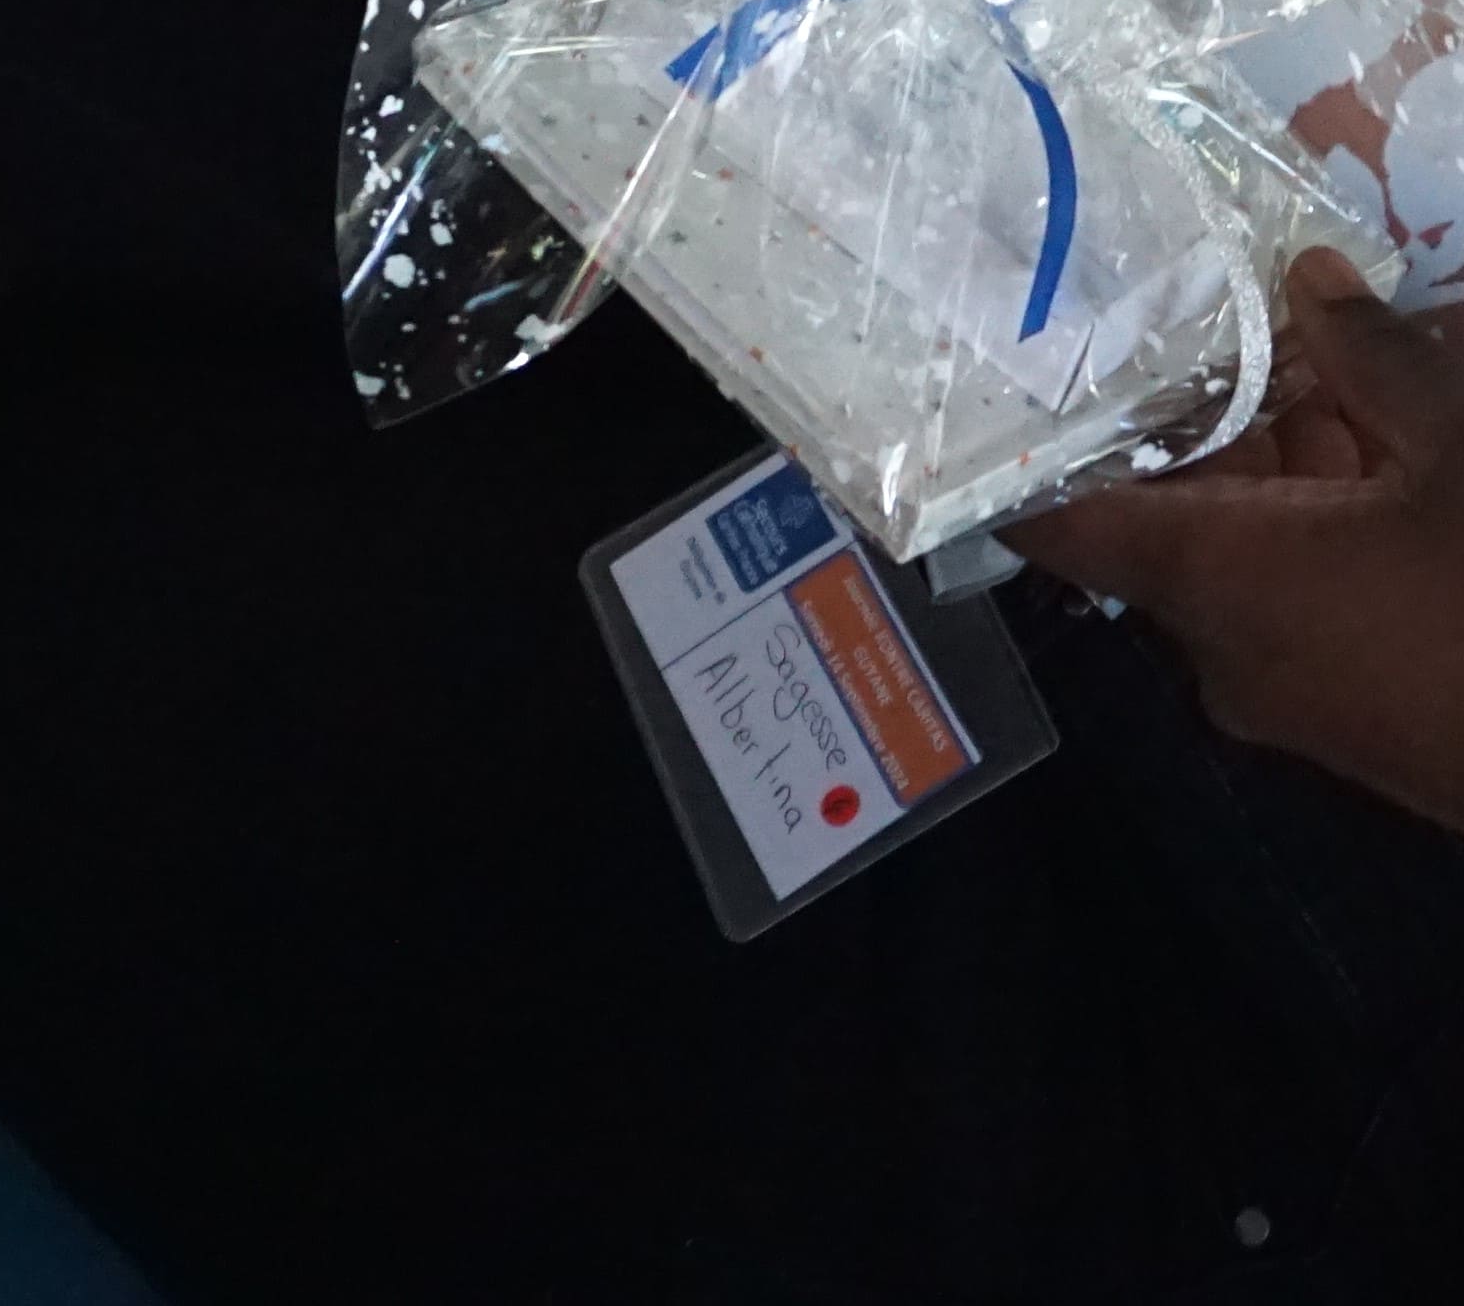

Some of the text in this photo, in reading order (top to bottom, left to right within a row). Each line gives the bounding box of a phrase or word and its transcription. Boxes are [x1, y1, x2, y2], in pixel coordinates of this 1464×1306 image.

[825, 652, 847, 675] 14
[850, 644, 894, 707] GUYANE
[764, 625, 849, 773] Sagesse
